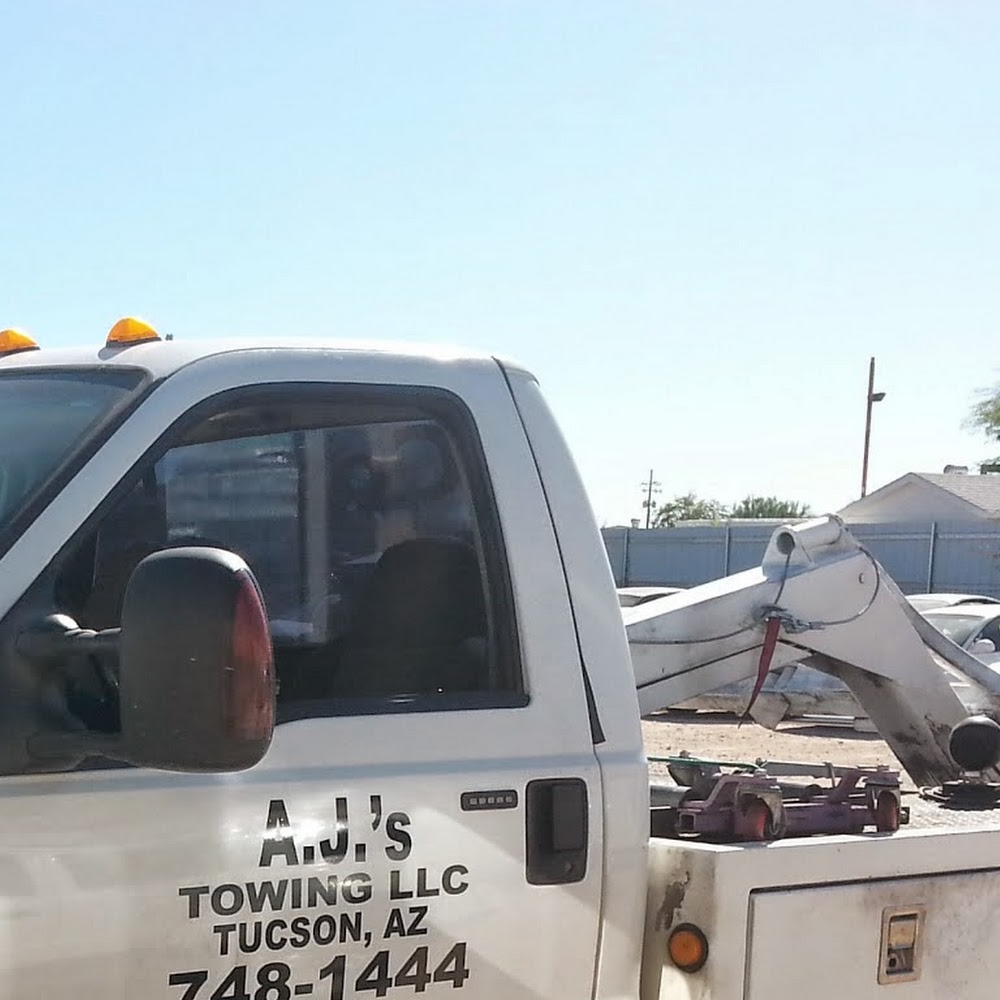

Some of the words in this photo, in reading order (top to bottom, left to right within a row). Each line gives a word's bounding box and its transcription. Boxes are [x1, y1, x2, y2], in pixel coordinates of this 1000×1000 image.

[259, 795, 412, 867] A.J.'s
[179, 873, 373, 919] TOWING
[389, 865, 470, 901] LLC
[213, 912, 372, 955] TUCSON,
[383, 906, 428, 939] AZ
